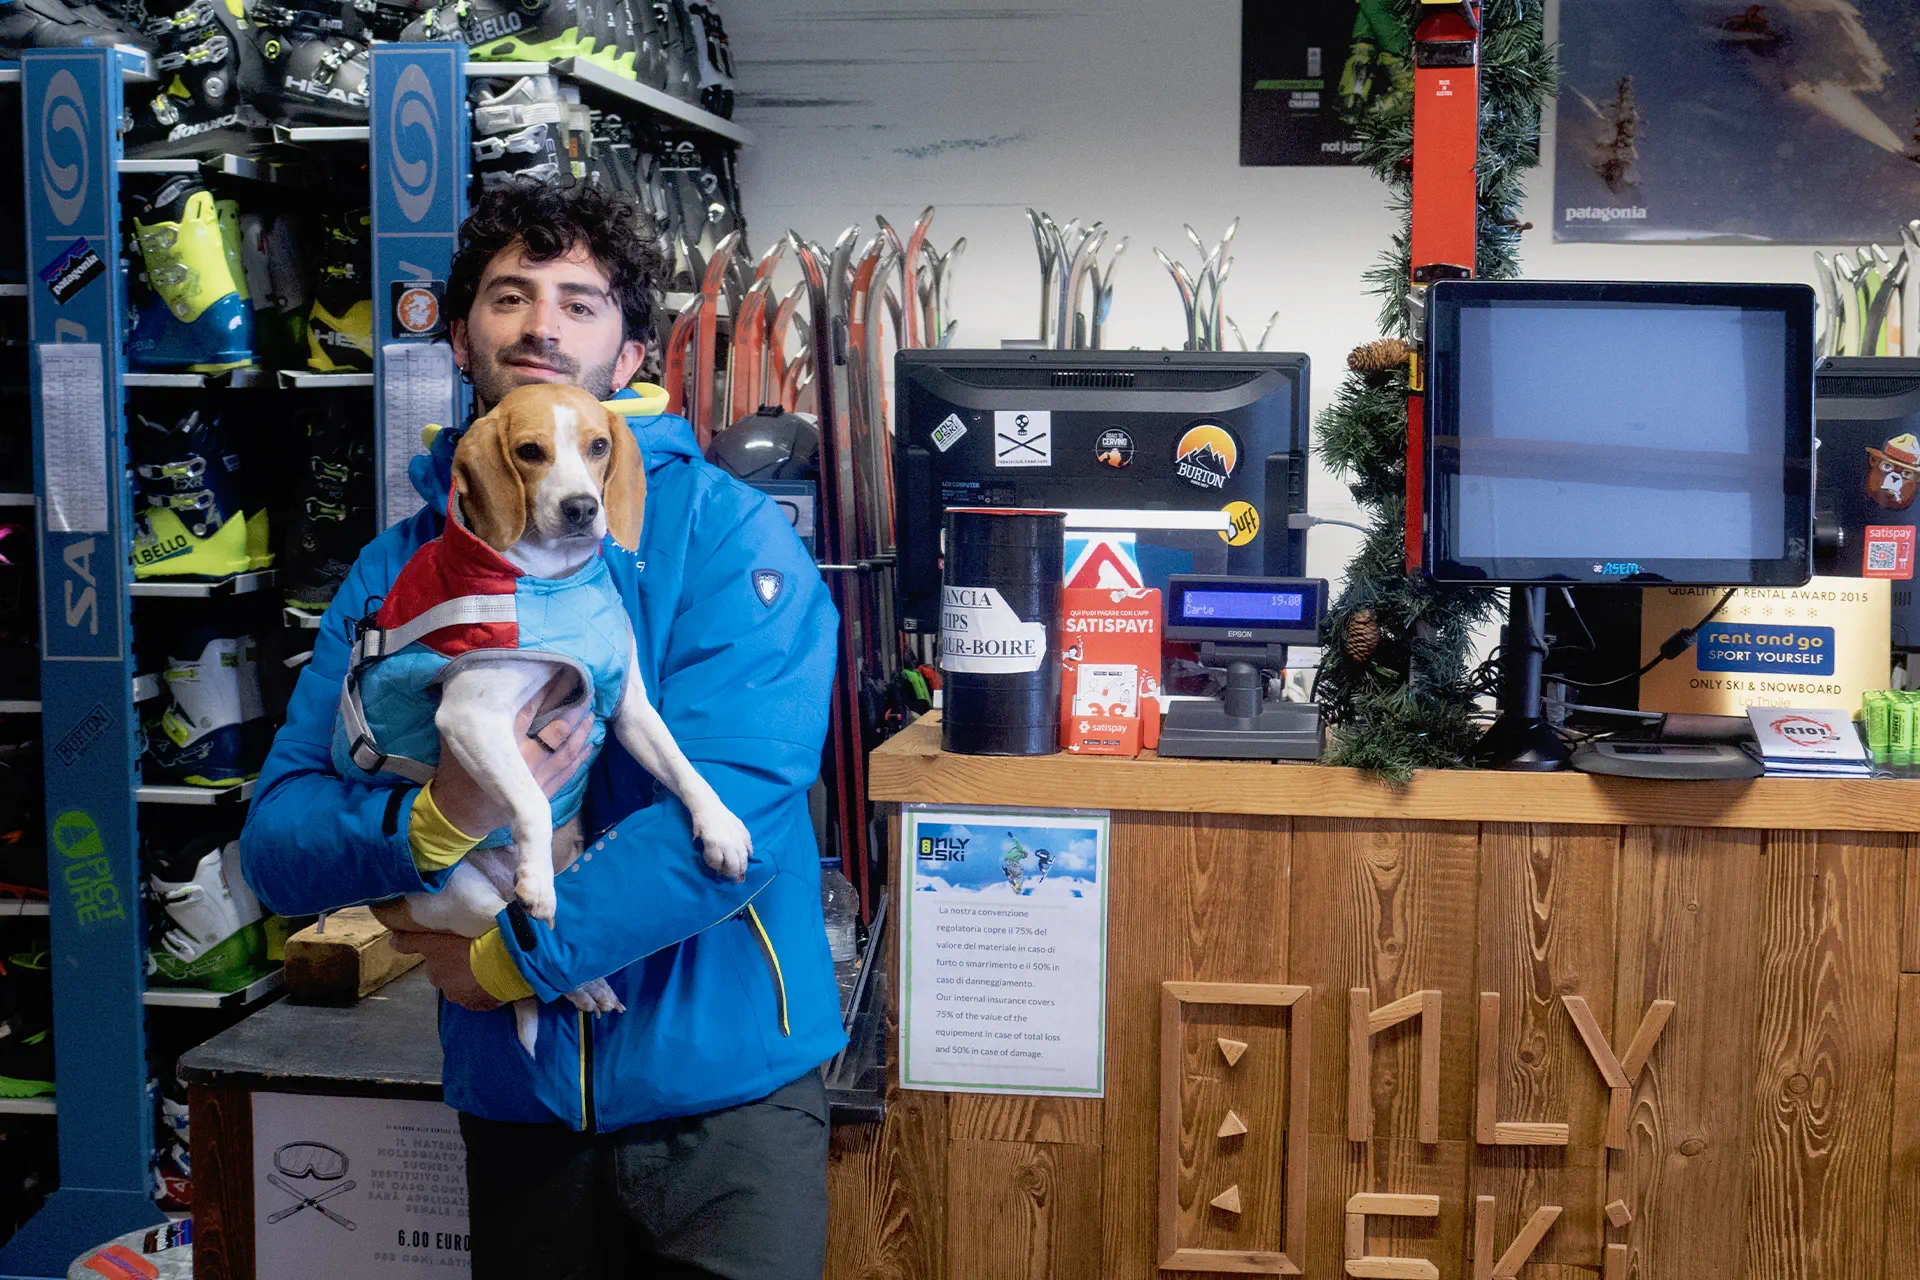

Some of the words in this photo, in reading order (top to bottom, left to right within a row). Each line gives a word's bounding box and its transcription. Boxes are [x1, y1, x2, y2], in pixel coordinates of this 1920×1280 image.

[1321, 142, 1340, 152] not
[1342, 141, 1362, 154] just
[1565, 206, 1647, 221] patagonia
[53, 254, 99, 296] patagonia
[1102, 437, 1128, 446] CERVINO
[1177, 462, 1226, 489] BURTON
[1869, 528, 1912, 540] satispay
[1603, 562, 1640, 575] ASEM
[1722, 588, 1740, 599] SI
[1744, 589, 1786, 600] RENTAL
[1791, 590, 1836, 601] AWARD
[1840, 592, 1868, 602] 2015
[1186, 604, 1215, 615] Carte
[1066, 618, 1154, 633] SATISPAY!
[1228, 630, 1253, 638] EPSON
[1709, 633, 1752, 645] rent
[1755, 633, 1794, 647] and
[1798, 637, 1823, 650] go
[1708, 651, 1752, 662] SPORT
[1756, 652, 1824, 664] YOURSELF
[1689, 678, 1722, 690] ONLY
[1726, 680, 1744, 691] SKI
[1747, 681, 1756, 691] &
[1760, 682, 1842, 695] SNOWBOARD
[1757, 697, 1791, 708] Thuile
[1091, 722, 1128, 734] satispay
[1784, 726, 1826, 736] R101
[950, 907, 976, 915] nostra
[978, 909, 1029, 918] convenzione
[936, 924, 982, 933] regolatoria
[1008, 926, 1014, 934] il
[1015, 927, 1033, 935] 75%
[1034, 928, 1047, 936] del
[936, 942, 962, 950] valore
[978, 944, 1017, 952] materiale
[1047, 946, 1056, 954] di
[936, 958, 958, 967] furto
[965, 960, 1018, 970] smarrimento
[1026, 961, 1031, 970] il
[1033, 962, 1051, 971] 50%
[1052, 964, 1060, 972] in
[936, 976, 955, 984] caso
[956, 976, 964, 984] di
[965, 976, 1035, 988] danneggiamento.
[936, 993, 952, 1001] Our
[954, 993, 986, 1003] internal
[987, 996, 1027, 1005] insurance
[936, 1010, 954, 1019] 75%
[965, 1011, 979, 1020] the
[980, 1013, 1002, 1021] value
[1003, 1014, 1012, 1022] of
[1013, 1014, 1028, 1022] the
[935, 1029, 983, 1037] equipement
[1014, 1032, 1022, 1040] of
[1045, 1033, 1061, 1041] loss
[952, 1046, 970, 1054] 50%
[1000, 1048, 1009, 1056] of
[1010, 1049, 1044, 1059] damage.
[398, 1229, 430, 1248] 6.00
[436, 1232, 471, 1252] EURO
